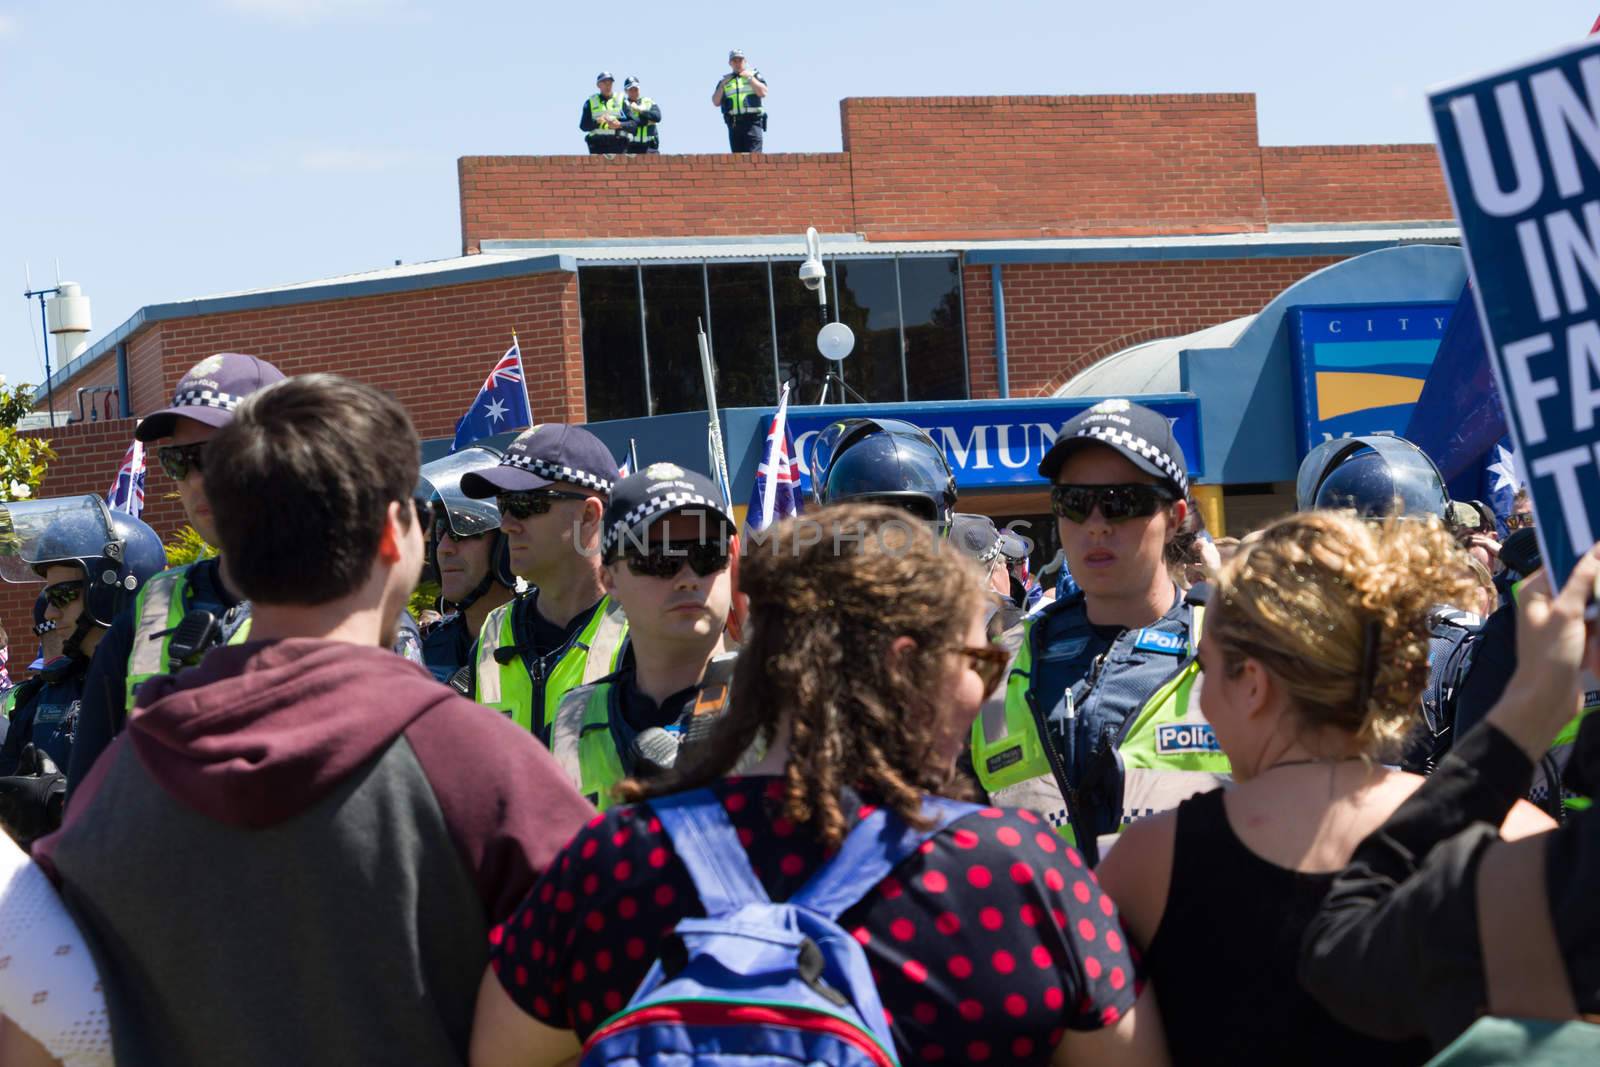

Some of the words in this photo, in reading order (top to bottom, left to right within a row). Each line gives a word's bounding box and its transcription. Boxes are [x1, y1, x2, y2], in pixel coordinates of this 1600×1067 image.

[1329, 317, 1444, 333] CITY
[1142, 631, 1190, 649] Polic
[1162, 726, 1216, 747] Polic
